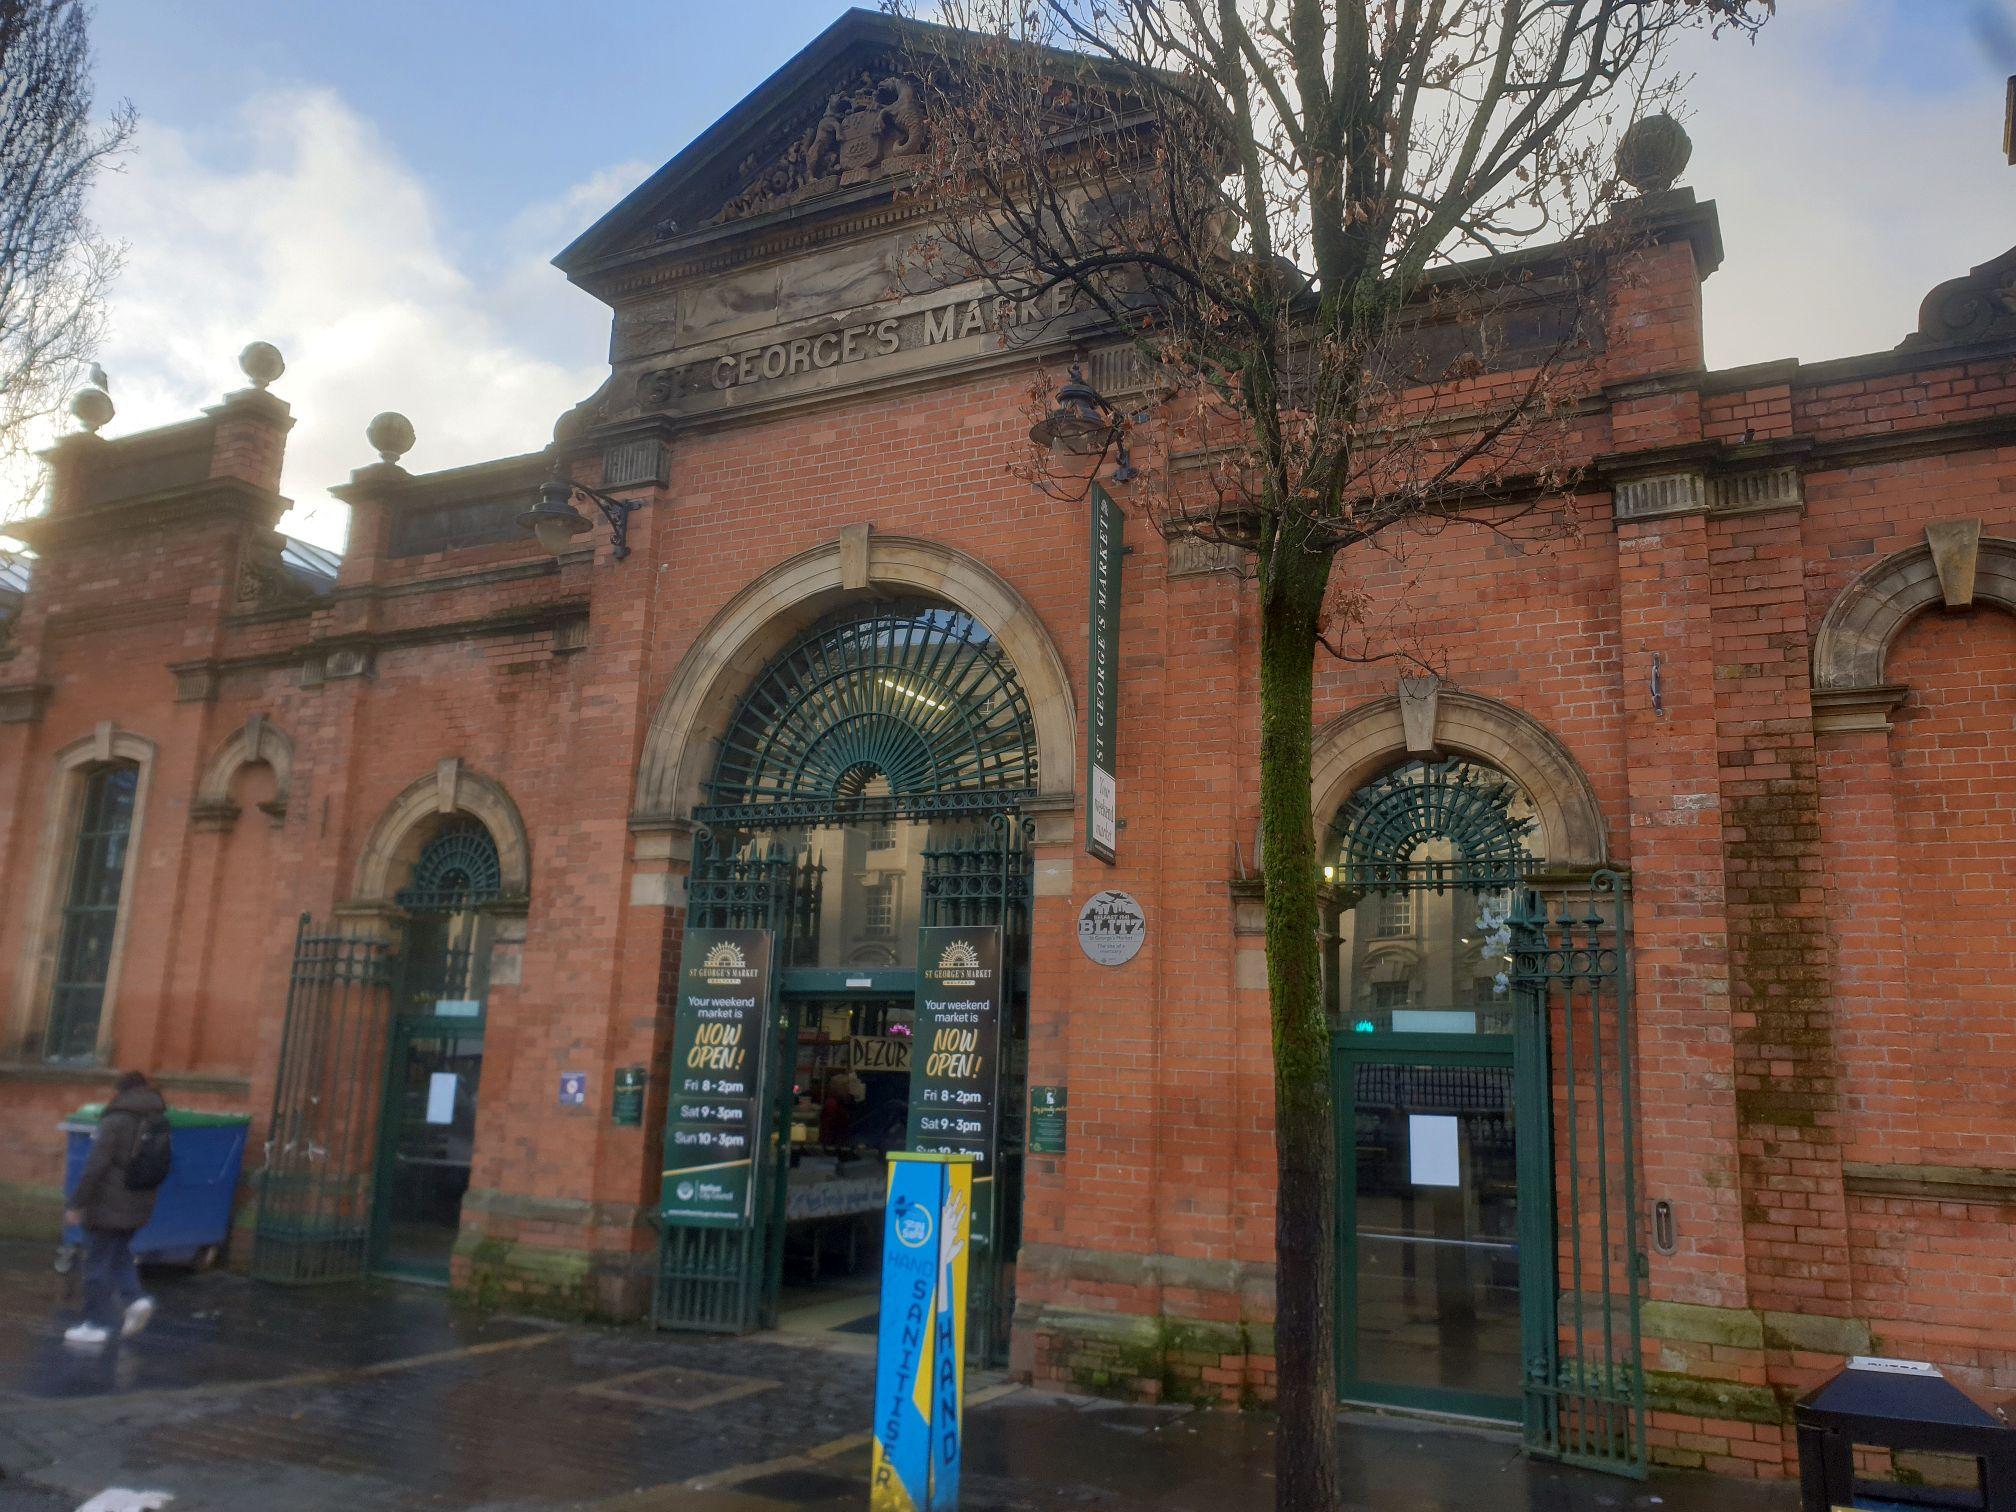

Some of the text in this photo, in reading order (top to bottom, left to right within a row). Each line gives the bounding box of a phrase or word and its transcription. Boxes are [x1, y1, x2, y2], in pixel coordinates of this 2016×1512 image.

[712, 319, 900, 389] GEORGE'S
[1095, 513, 1109, 763] ST GEORGE'S MARKET
[1079, 919, 1144, 934] BLITZ
[699, 968, 731, 978] GEORGE'S
[732, 968, 758, 978] MARKET
[925, 969, 992, 979] ST GEORGE'S MARKET
[688, 996, 755, 1007] Your weekend
[925, 1000, 990, 1010] Your weekend
[698, 1008, 743, 1018] market is
[935, 1012, 979, 1023] market is
[695, 1022, 742, 1046] NOW
[933, 1028, 978, 1052] NOW
[687, 1046, 745, 1070] OPEN!
[926, 1052, 982, 1079] OPEN!
[684, 1079, 698, 1091] Fri
[923, 1089, 938, 1101] Fri
[680, 1105, 699, 1119] Sat
[921, 1117, 939, 1130] Sat
[674, 1131, 697, 1145] Sun
[938, 1315, 957, 1465] HAND
